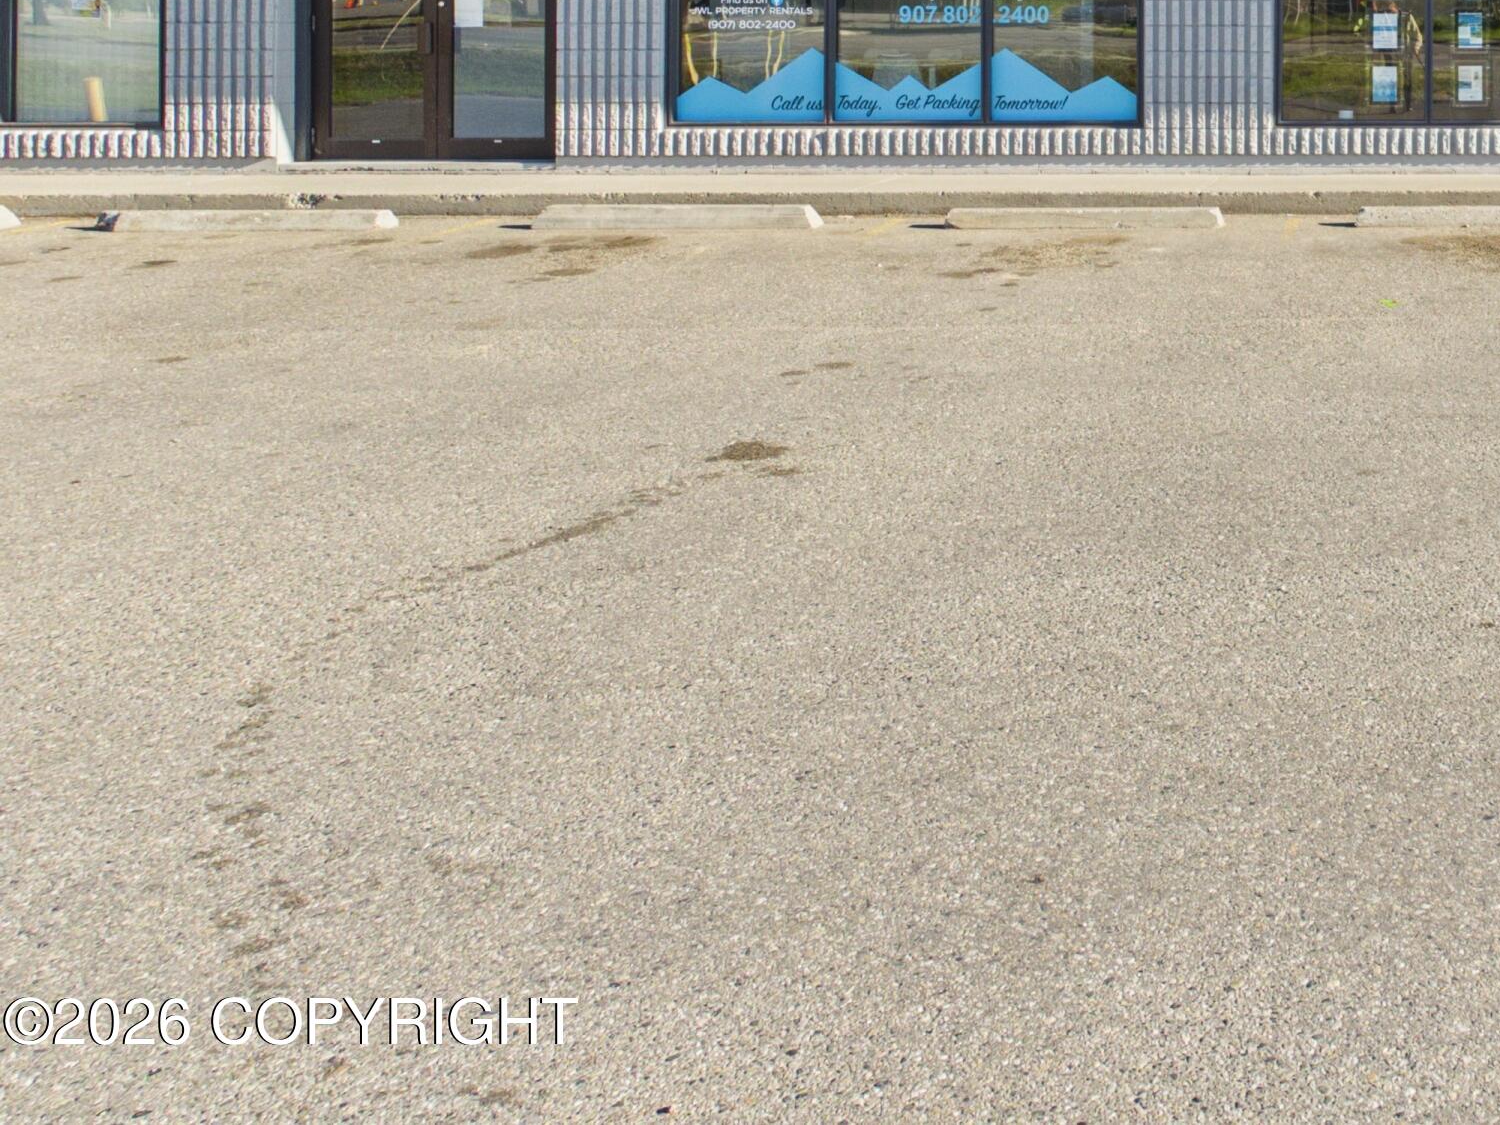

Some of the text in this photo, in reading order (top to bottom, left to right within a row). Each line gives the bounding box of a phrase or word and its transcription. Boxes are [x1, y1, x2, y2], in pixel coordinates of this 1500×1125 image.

[715, 7, 767, 15] PROPERTY
[769, 7, 813, 15] RENTALS
[899, 5, 1049, 24] 907.802.2400
[707, 19, 796, 30] (907) 802-2400
[771, 94, 1068, 117] Call us Today. Get Packing Tomorrow!
